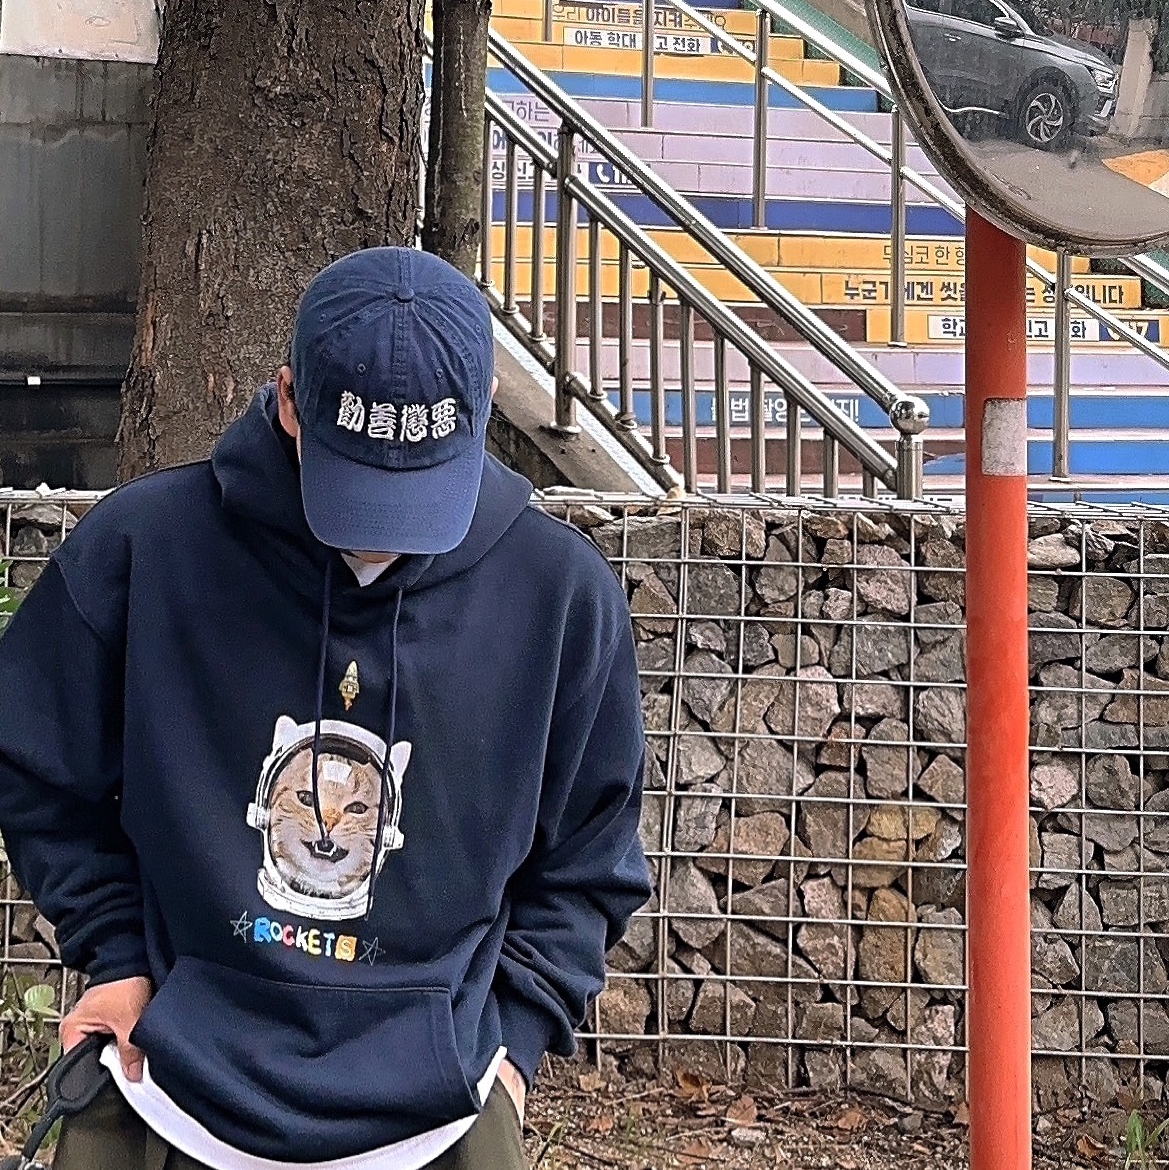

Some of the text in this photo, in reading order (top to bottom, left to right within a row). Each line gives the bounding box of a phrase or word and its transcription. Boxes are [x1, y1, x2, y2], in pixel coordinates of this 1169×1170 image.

[653, 11, 727, 32] 지켜주요
[574, 30, 603, 46] 아동
[607, 32, 637, 48] 학대
[672, 37, 701, 53] 전화
[254, 916, 358, 962] ROCKETS
